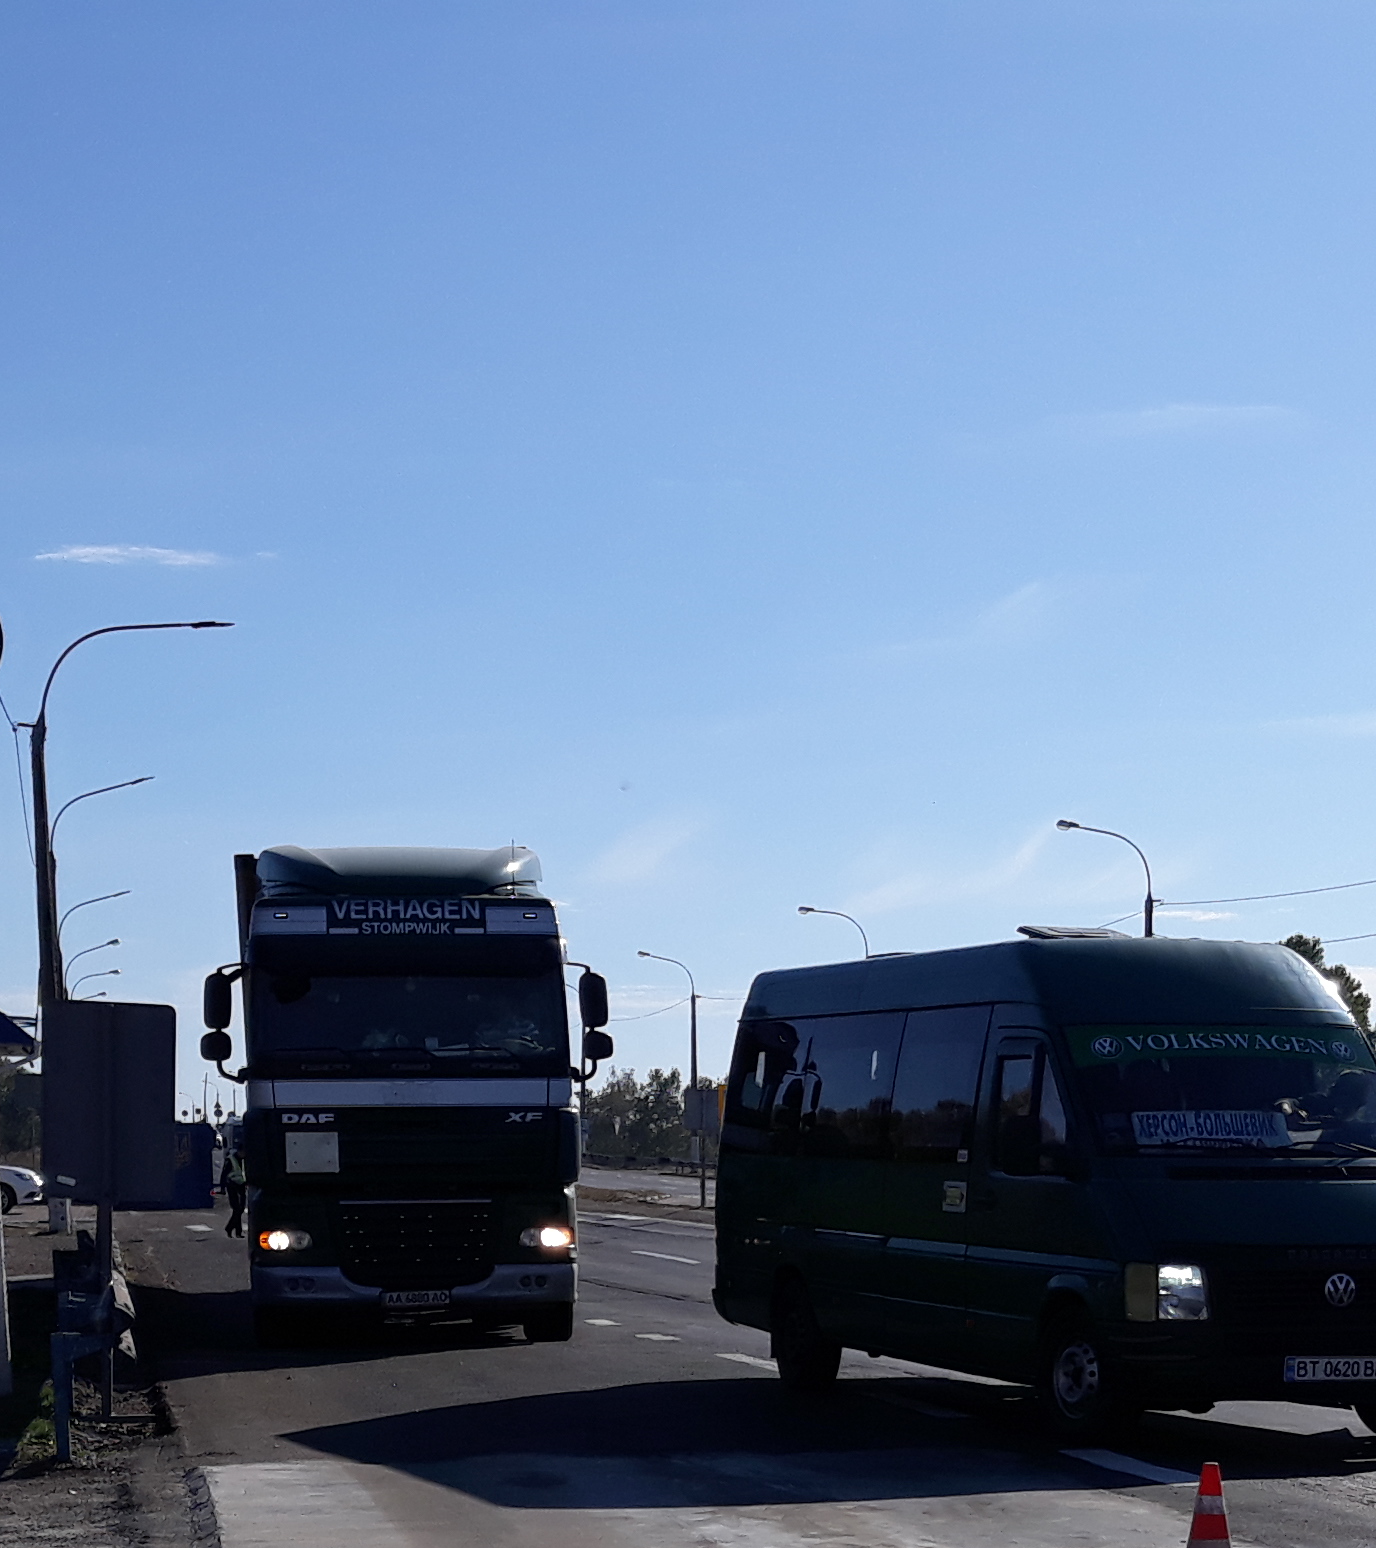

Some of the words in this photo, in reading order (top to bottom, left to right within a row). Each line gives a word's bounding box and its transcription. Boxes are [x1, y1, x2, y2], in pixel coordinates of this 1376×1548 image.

[331, 899, 481, 921] VERHAGEN
[361, 922, 451, 936] STOMPWIJK
[1125, 1032, 1329, 1056] VOLKSWAGEN
[281, 1113, 335, 1124] DAF
[504, 1111, 543, 1123] XF
[1296, 1360, 1321, 1378] BT
[1323, 1359, 1360, 1378] 0620
